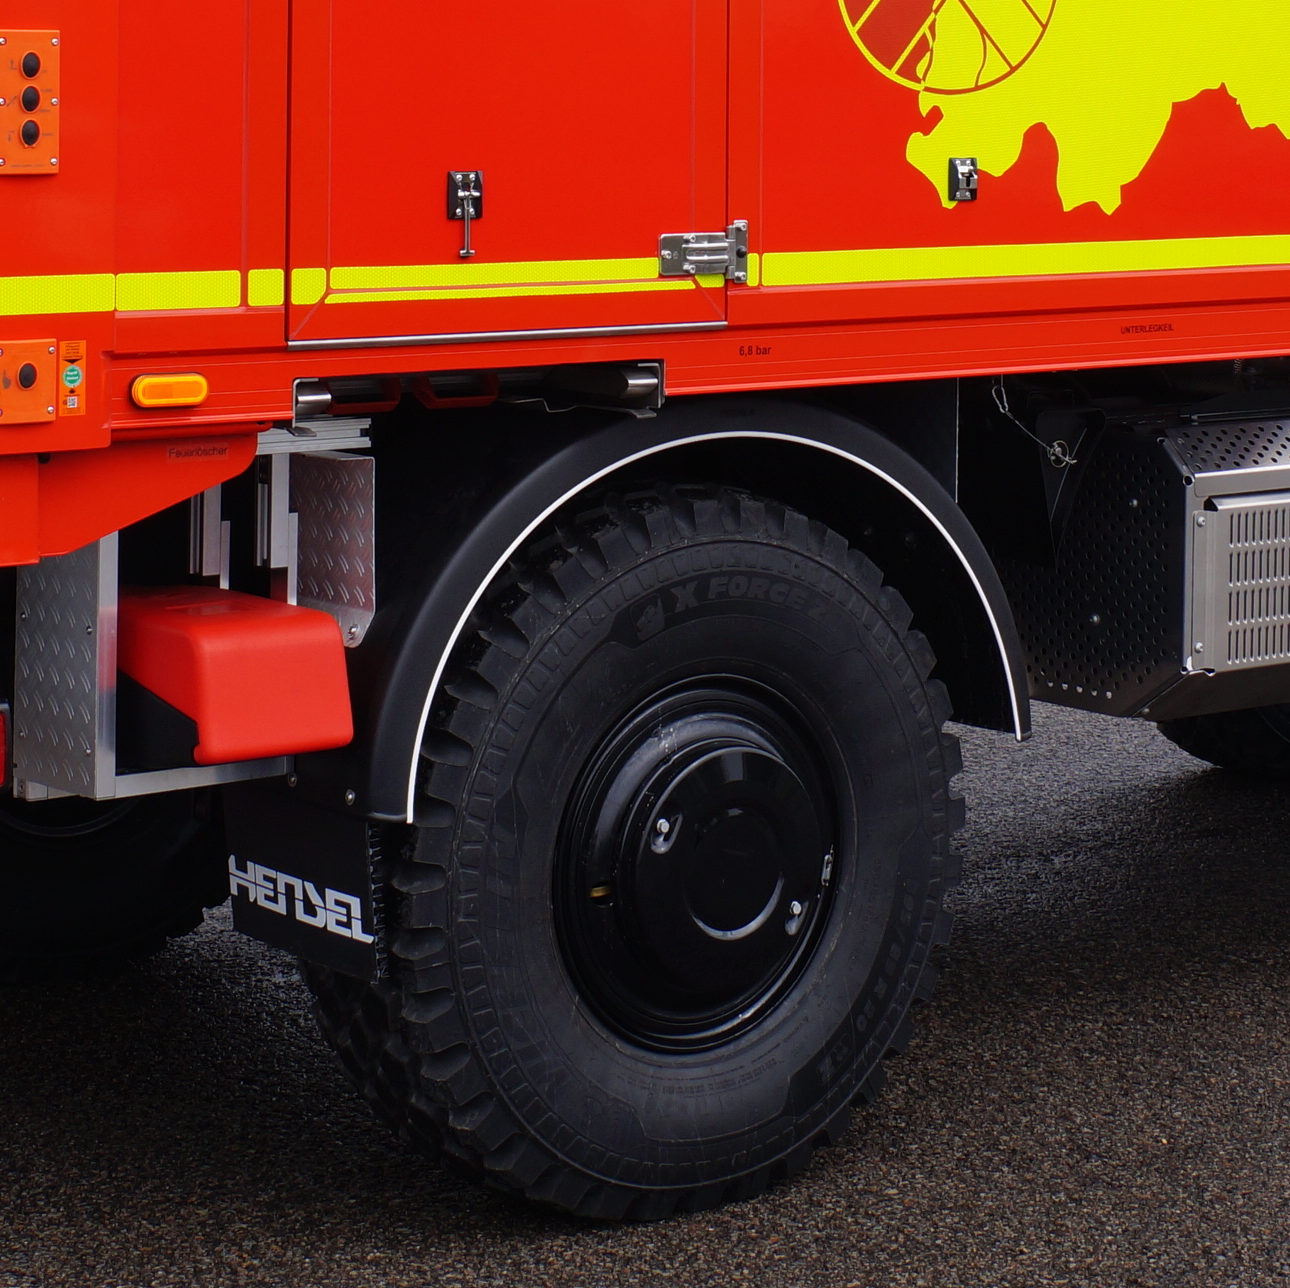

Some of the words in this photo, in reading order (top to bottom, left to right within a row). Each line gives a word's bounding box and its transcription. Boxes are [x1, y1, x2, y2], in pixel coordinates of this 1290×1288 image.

[1120, 323, 1174, 335] UNTERLEGKEIL
[739, 345, 753, 357] 6,8
[756, 345, 772, 355] bar
[169, 446, 228, 458] Feuerlöscher
[707, 575, 808, 610] FORCE
